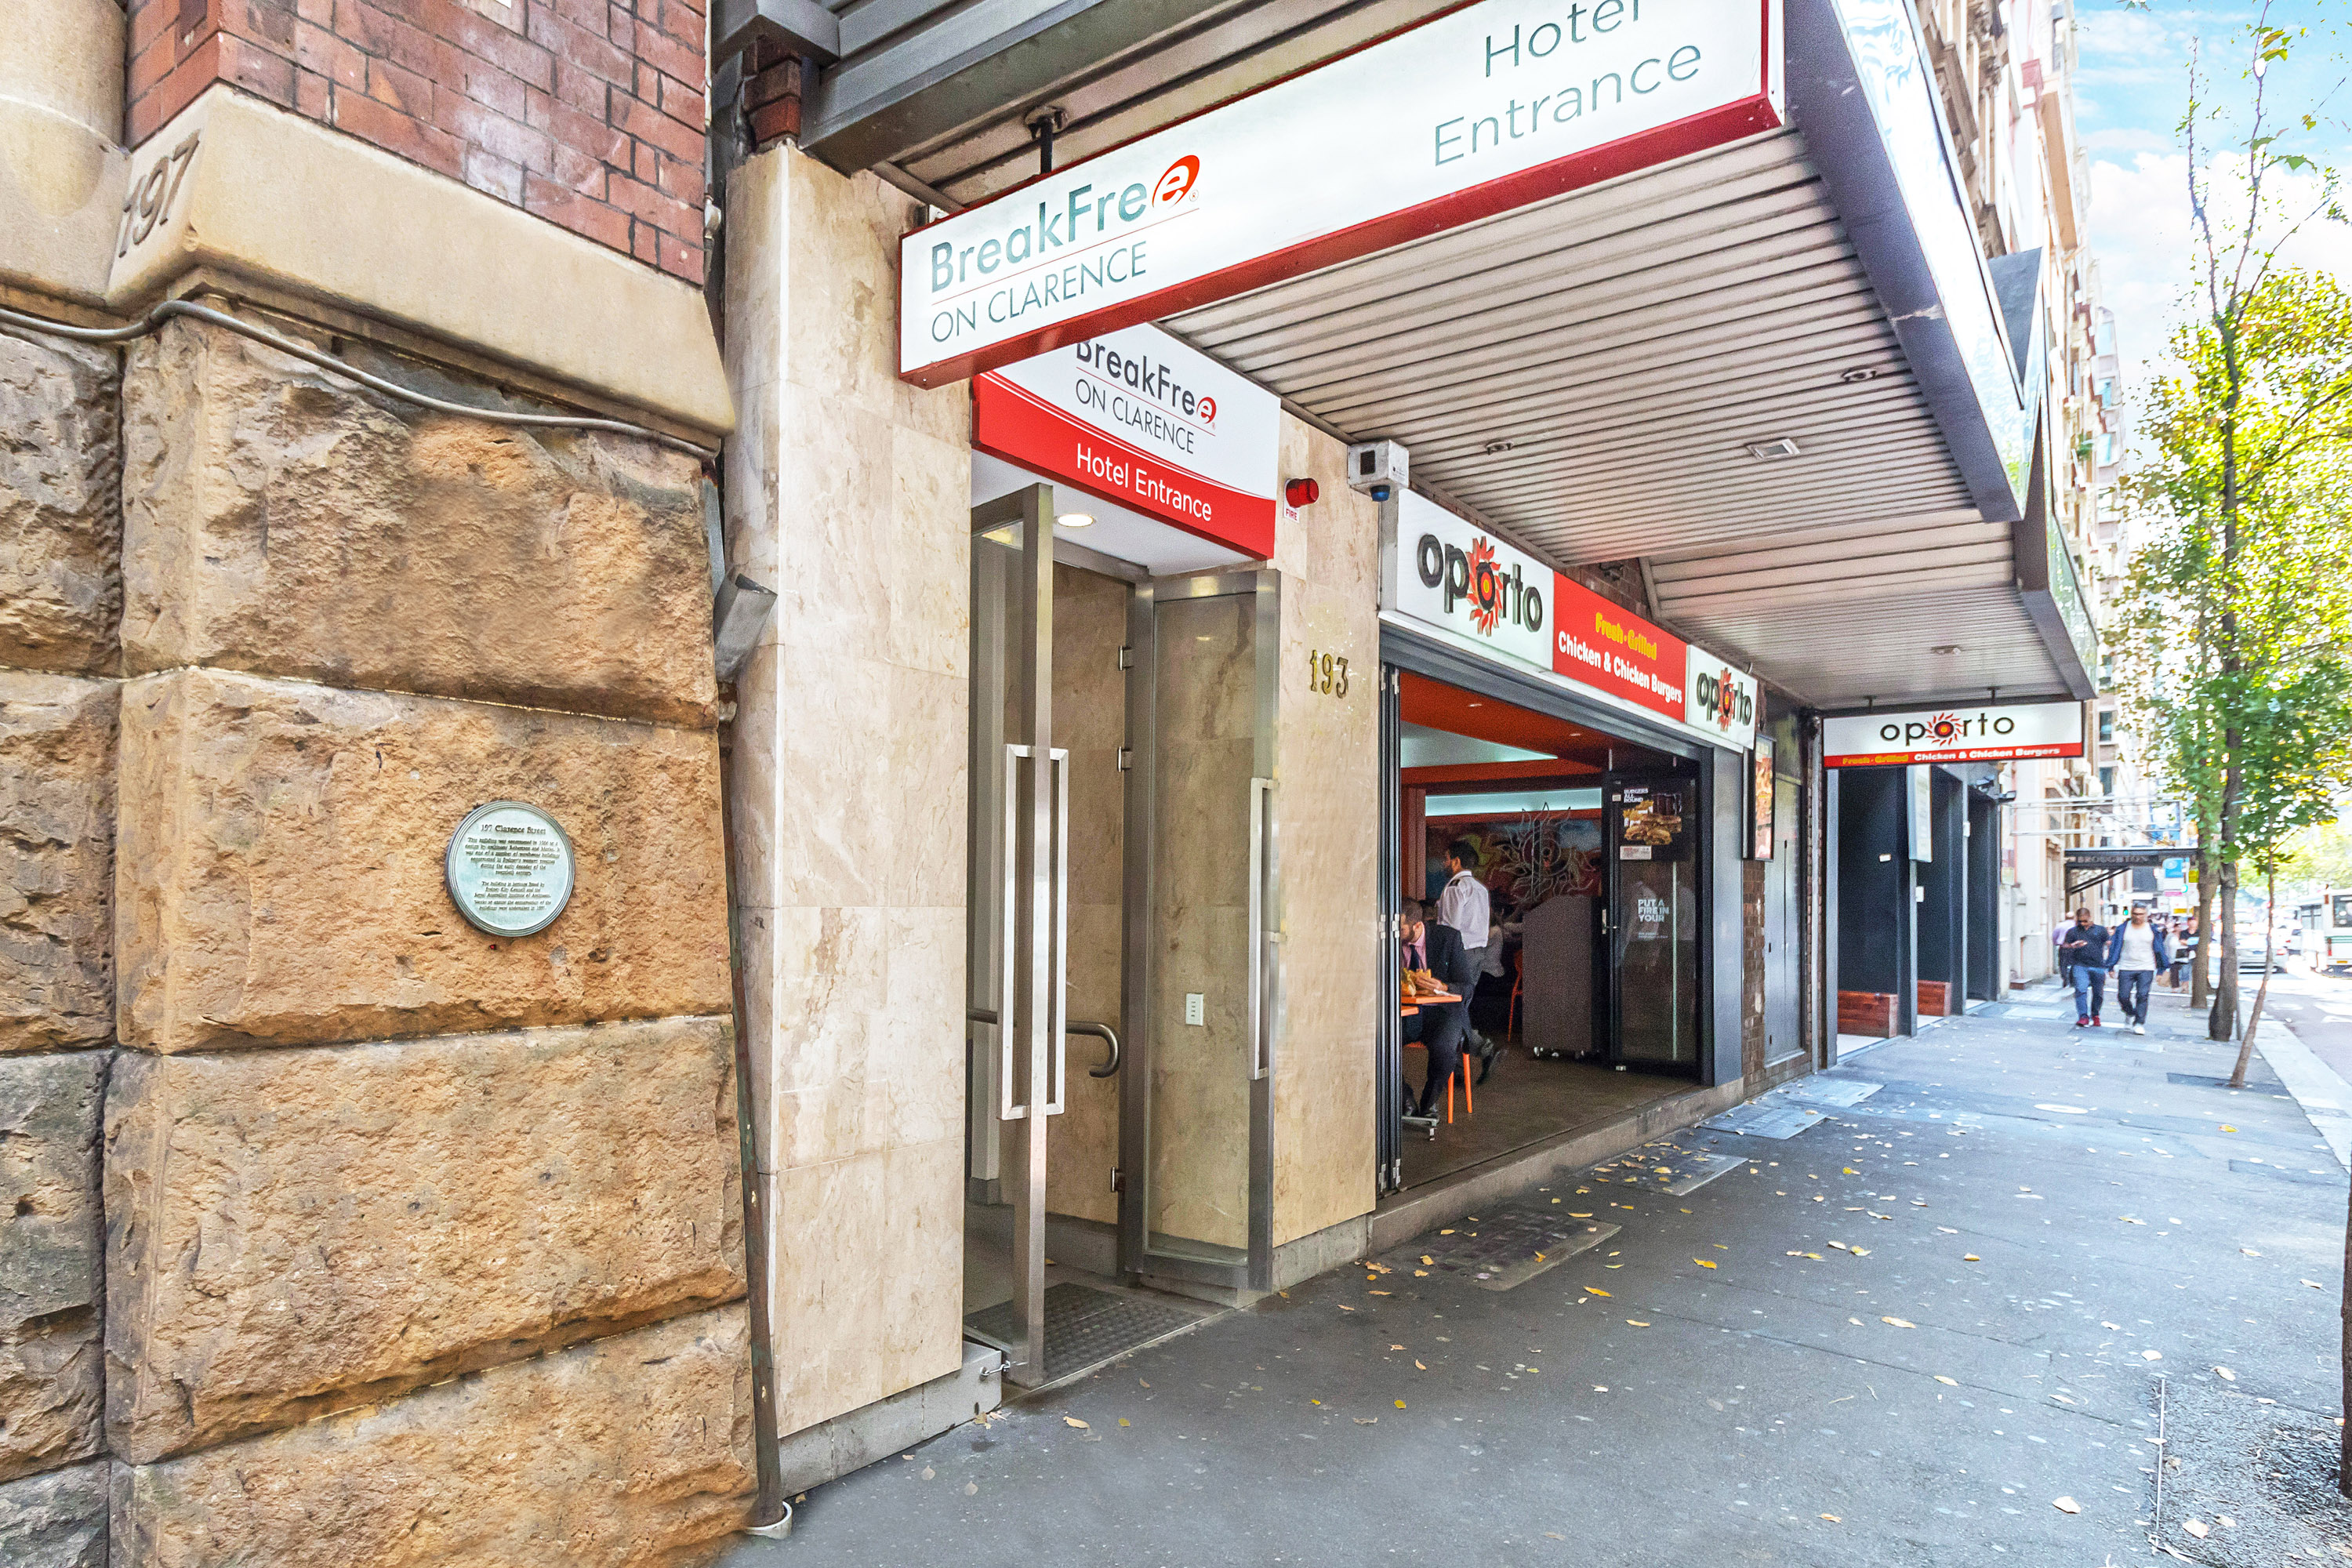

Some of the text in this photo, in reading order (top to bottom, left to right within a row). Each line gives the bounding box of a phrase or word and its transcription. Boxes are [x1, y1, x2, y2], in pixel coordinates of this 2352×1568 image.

[1435, 45, 1701, 167] Entrance
[118, 128, 201, 259] 197
[931, 154, 1200, 293] BreakFree
[931, 241, 1147, 343] ON CLARENCE
[1076, 379, 1195, 455] ON CLARENCE
[1076, 442, 1212, 522] Hotel Entrance
[1286, 507, 1298, 521] FIRE
[1416, 533, 1544, 633] oporto
[1309, 649, 1349, 699] 193
[1558, 630, 1682, 705] Chicken & Chicken Burgers
[1696, 672, 1753, 727] oporto
[1879, 712, 2015, 747] oporto
[1914, 746, 2060, 762] Chicken & Chicken Burgers
[495, 825, 524, 833] Clarence
[527, 826, 546, 835] Street
[1638, 898, 1665, 907] PUT A
[1638, 914, 1665, 923] YOUR
[1659, 906, 1669, 915] IN
